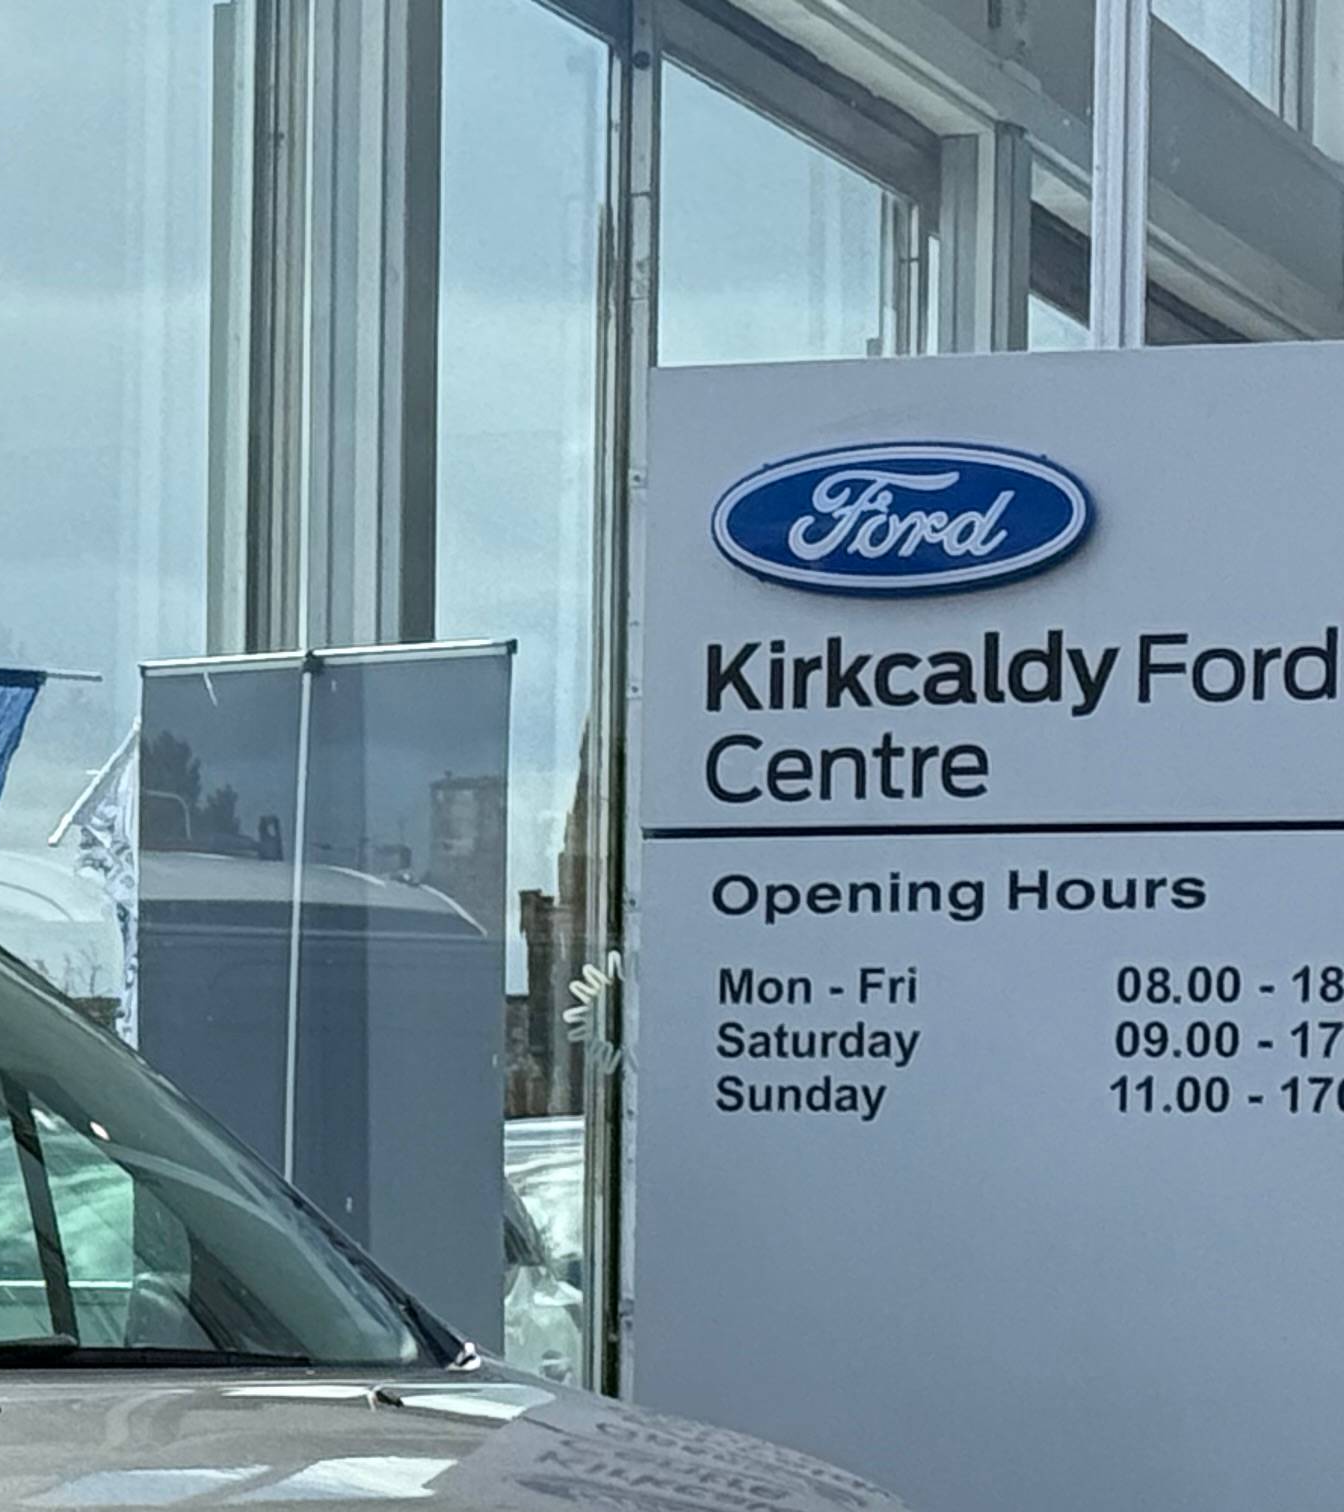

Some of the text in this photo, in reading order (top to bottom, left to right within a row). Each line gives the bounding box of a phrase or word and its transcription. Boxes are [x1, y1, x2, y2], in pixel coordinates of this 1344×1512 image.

[789, 470, 1015, 560] Ford
[707, 626, 1338, 716] Kirkcaldy Ford
[706, 732, 989, 803] Centre
[712, 869, 1208, 925] Opening Hours
[719, 967, 812, 1004] Mon
[860, 967, 917, 1004] Fri
[1117, 966, 1241, 1004] 08.00
[716, 1021, 921, 1068] Saturday
[1115, 1021, 1240, 1058] 09.00
[716, 1075, 887, 1122] Sunday
[1110, 1075, 1230, 1114] 11.00
